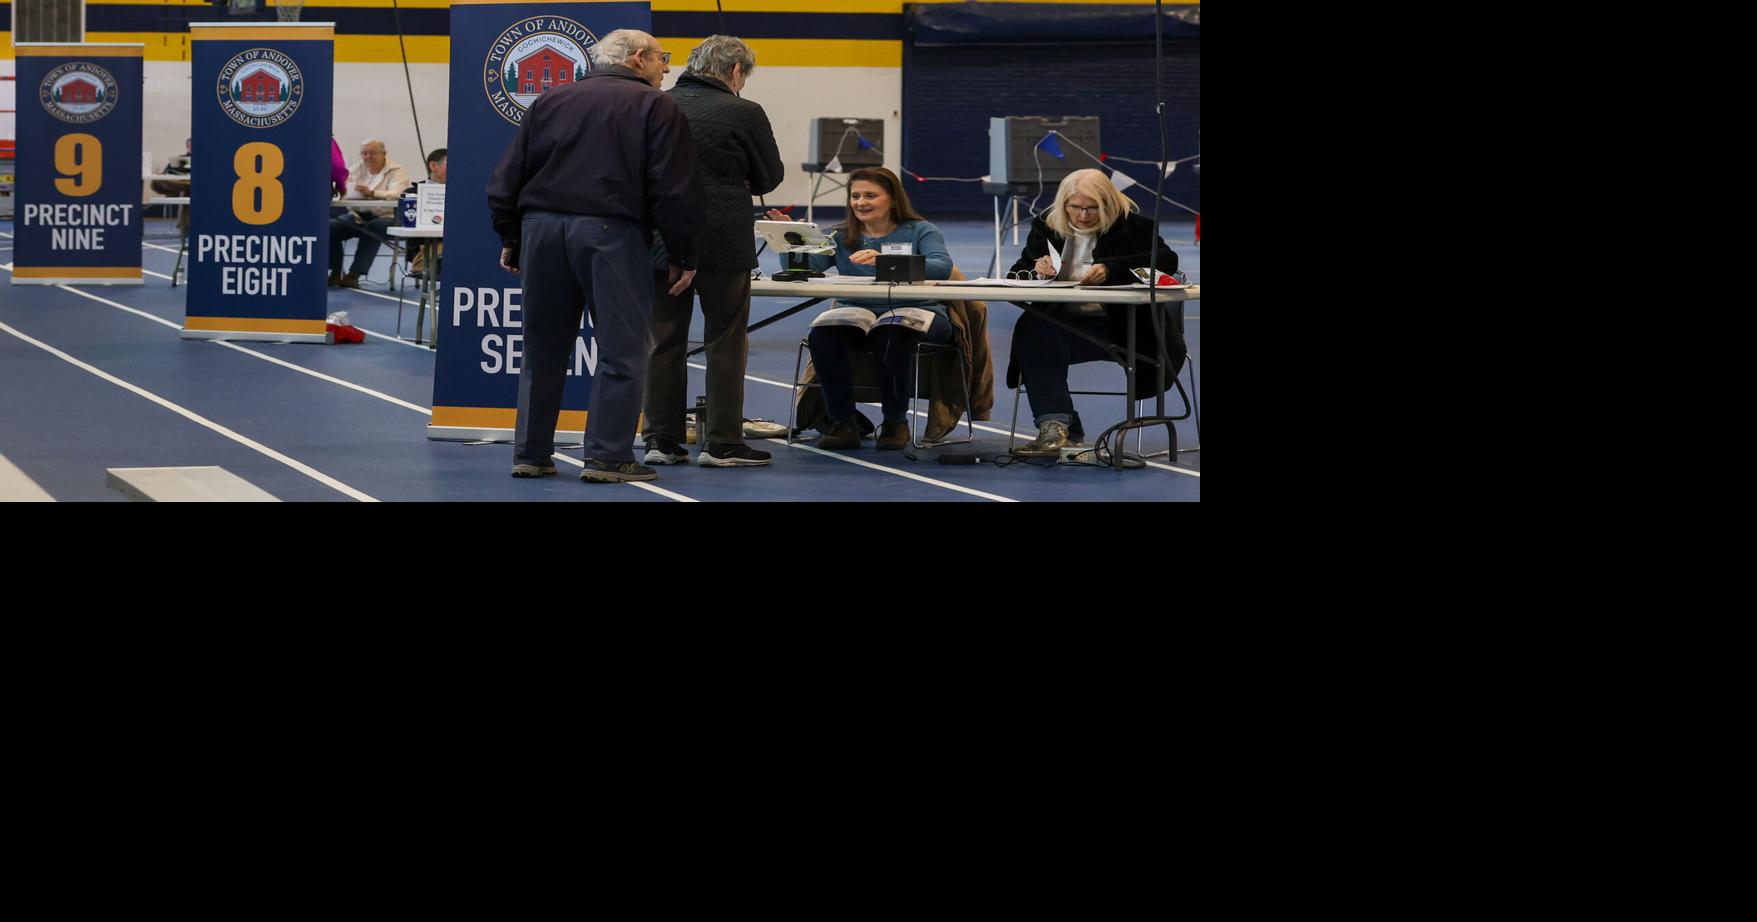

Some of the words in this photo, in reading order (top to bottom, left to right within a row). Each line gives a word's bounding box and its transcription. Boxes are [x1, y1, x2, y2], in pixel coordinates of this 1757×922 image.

[490, 27, 523, 61] TOWN
[525, 19, 545, 33] OF
[548, 19, 599, 55] ANDOV
[517, 36, 575, 53] COCHICHEWICK
[221, 56, 244, 80] TOWN
[245, 51, 259, 60] OF
[261, 51, 299, 81] ANDOVER
[223, 99, 297, 126] MASSACHUSETTS
[54, 133, 102, 197] 9
[232, 141, 284, 225] 8
[24, 203, 134, 226] PRECINCT
[51, 228, 105, 250] NINE
[198, 234, 317, 265] PRECINCT
[222, 266, 292, 296] EIGHT
[480, 333, 599, 377] SEN
